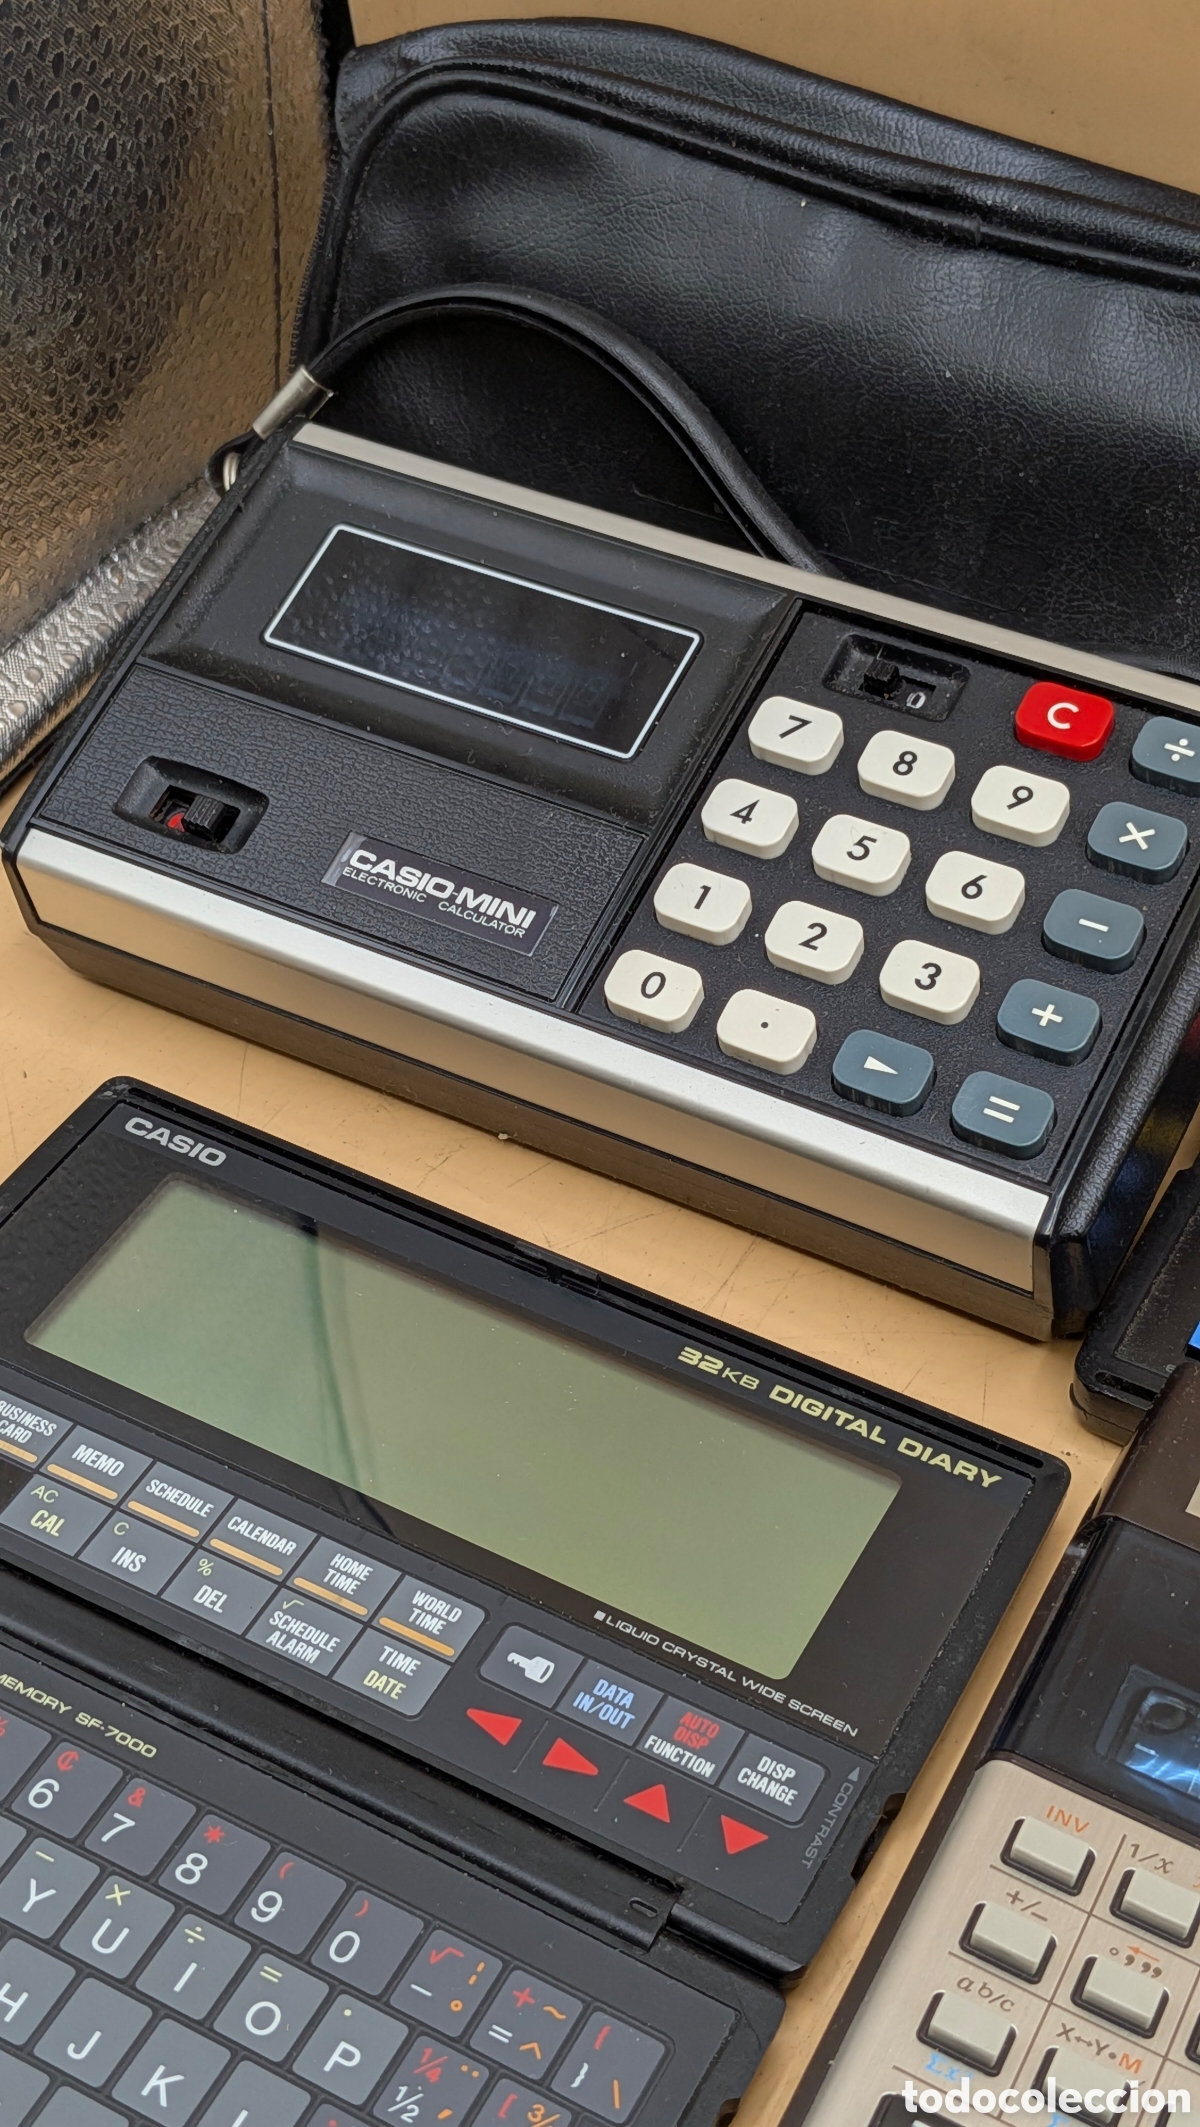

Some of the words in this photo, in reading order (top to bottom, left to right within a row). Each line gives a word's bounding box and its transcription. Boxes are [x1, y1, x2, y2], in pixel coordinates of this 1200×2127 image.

[778, 715, 811, 739] 7
[1047, 702, 1080, 730] C
[893, 751, 918, 777] 8
[729, 799, 760, 825] 4
[1006, 785, 1034, 811] 9
[846, 835, 878, 861] 5
[343, 867, 427, 903] ELECTRONIC
[438, 901, 526, 938] CALCULATOR
[349, 849, 537, 929] CASIO-MINI
[694, 884, 712, 911] 1
[961, 874, 988, 900] 6
[798, 922, 828, 951] 2
[641, 971, 667, 999] 0
[914, 962, 943, 991] 3
[125, 1117, 227, 1167] CASIO
[677, 1346, 760, 1390] 32KB
[769, 1384, 887, 1445] DIGITAL
[897, 1437, 1002, 1488] DIARY
[72, 1444, 125, 1477] MEMO
[30, 1485, 59, 1503] AC
[145, 1479, 215, 1518] SCHEDULE
[30, 1510, 65, 1537] CAL
[113, 1522, 130, 1536] C
[227, 1516, 297, 1556] CALENDAR
[111, 1546, 147, 1572] INS
[198, 1558, 214, 1577] %
[330, 1553, 374, 1581] HOME
[324, 1568, 361, 1596] TIME
[193, 1584, 229, 1614] DEL
[412, 1590, 463, 1624] WORLD
[269, 1610, 341, 1654] SCHEDULE
[407, 1606, 447, 1636] TIME
[265, 1631, 321, 1665] ALARM
[380, 1645, 422, 1678] TIME
[363, 1669, 407, 1701] DATE
[605, 1615, 660, 1646] LIQUID
[661, 1641, 738, 1682] CRYSTAL
[742, 1679, 788, 1705] WIDE
[787, 1699, 859, 1738] SCREEN
[592, 1678, 636, 1708] DATA
[573, 1691, 636, 1730] IN/OUT
[678, 1711, 721, 1740] AUTO
[673, 1725, 711, 1750] DISP
[644, 1735, 716, 1778] FUNCTION
[756, 1755, 797, 1781] DISP
[28, 1777, 60, 1808] 6
[736, 1767, 799, 1807] CHANGE
[101, 1812, 135, 1843] 7
[801, 1782, 854, 1870] CONTRAST
[1046, 1805, 1090, 1834] INV
[175, 1852, 208, 1885] 8
[22, 1878, 57, 1913] Y
[250, 1890, 283, 1923] 9
[91, 1918, 130, 1954] U
[173, 1962, 198, 1993] I
[0, 1982, 29, 2023] H
[244, 2000, 282, 2036] O
[67, 2030, 102, 2060] J
[323, 2040, 362, 2073] P
[141, 2064, 185, 2108] K
